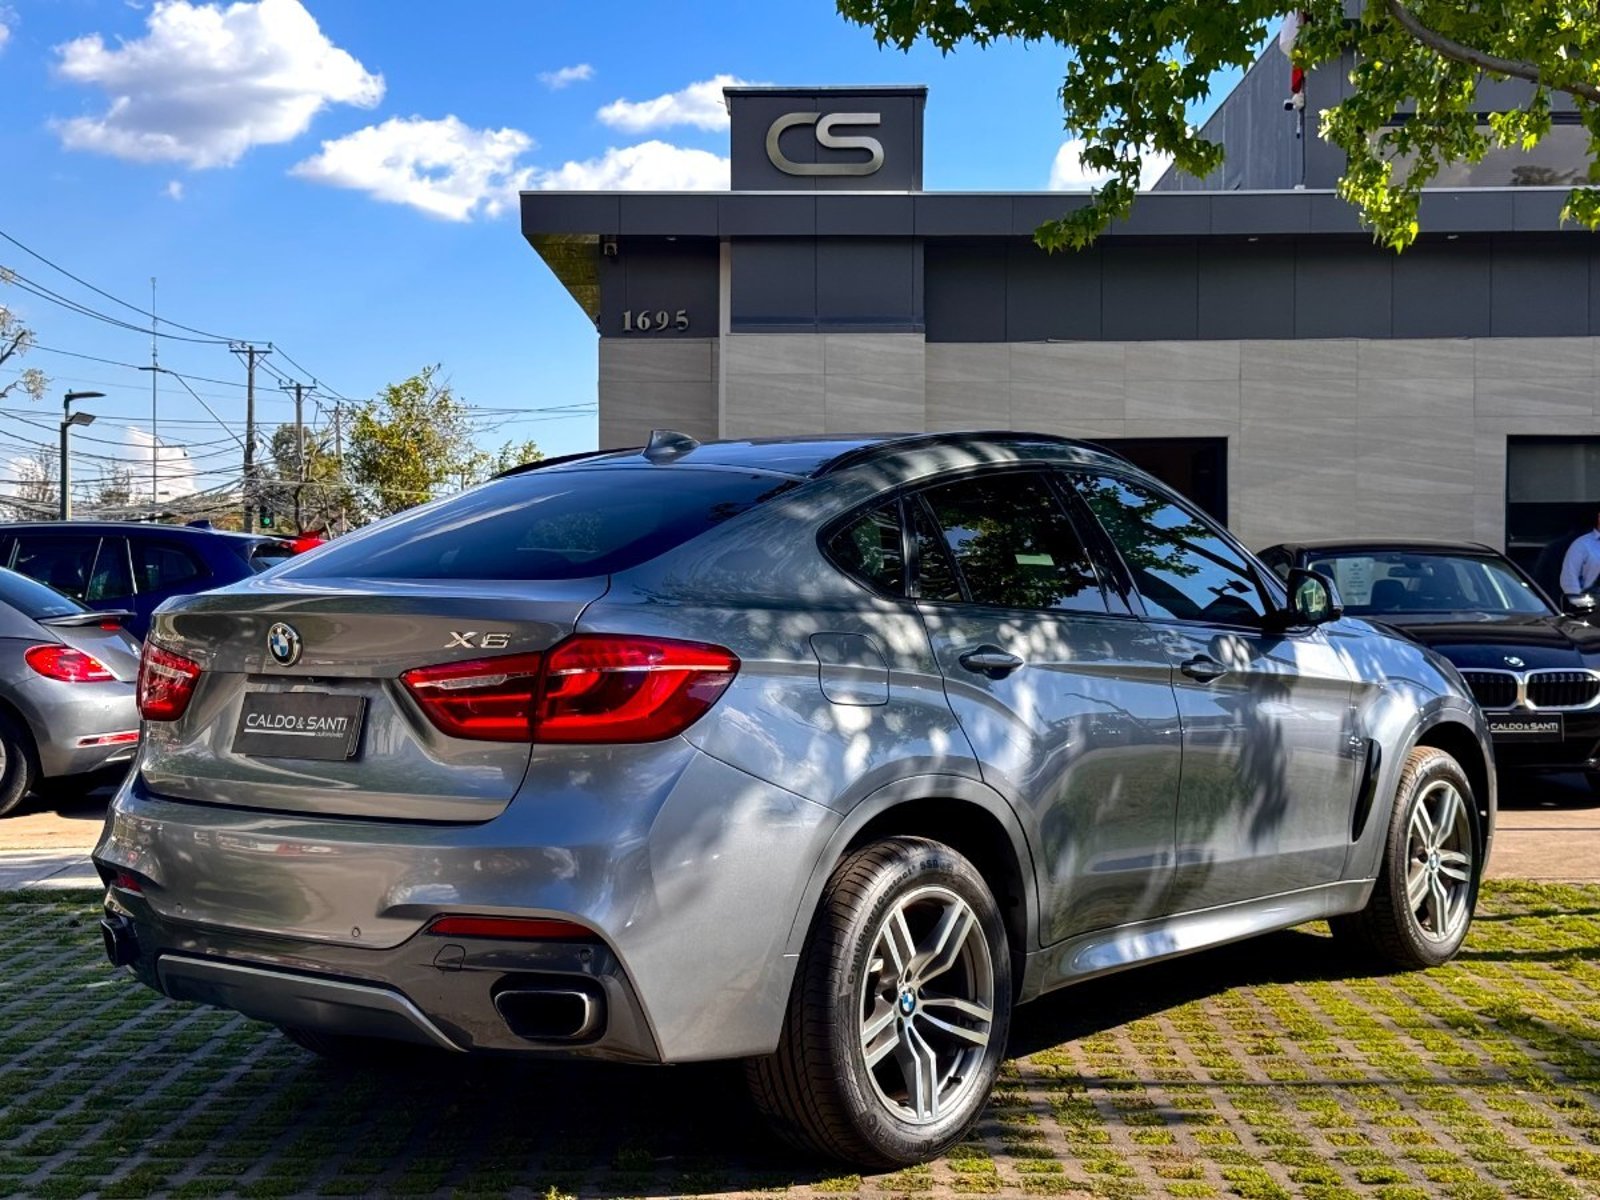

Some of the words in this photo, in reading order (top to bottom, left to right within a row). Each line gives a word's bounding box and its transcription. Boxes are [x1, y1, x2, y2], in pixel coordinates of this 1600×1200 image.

[766, 112, 885, 175] CS
[623, 309, 689, 331] 1695
[443, 631, 512, 648] X6
